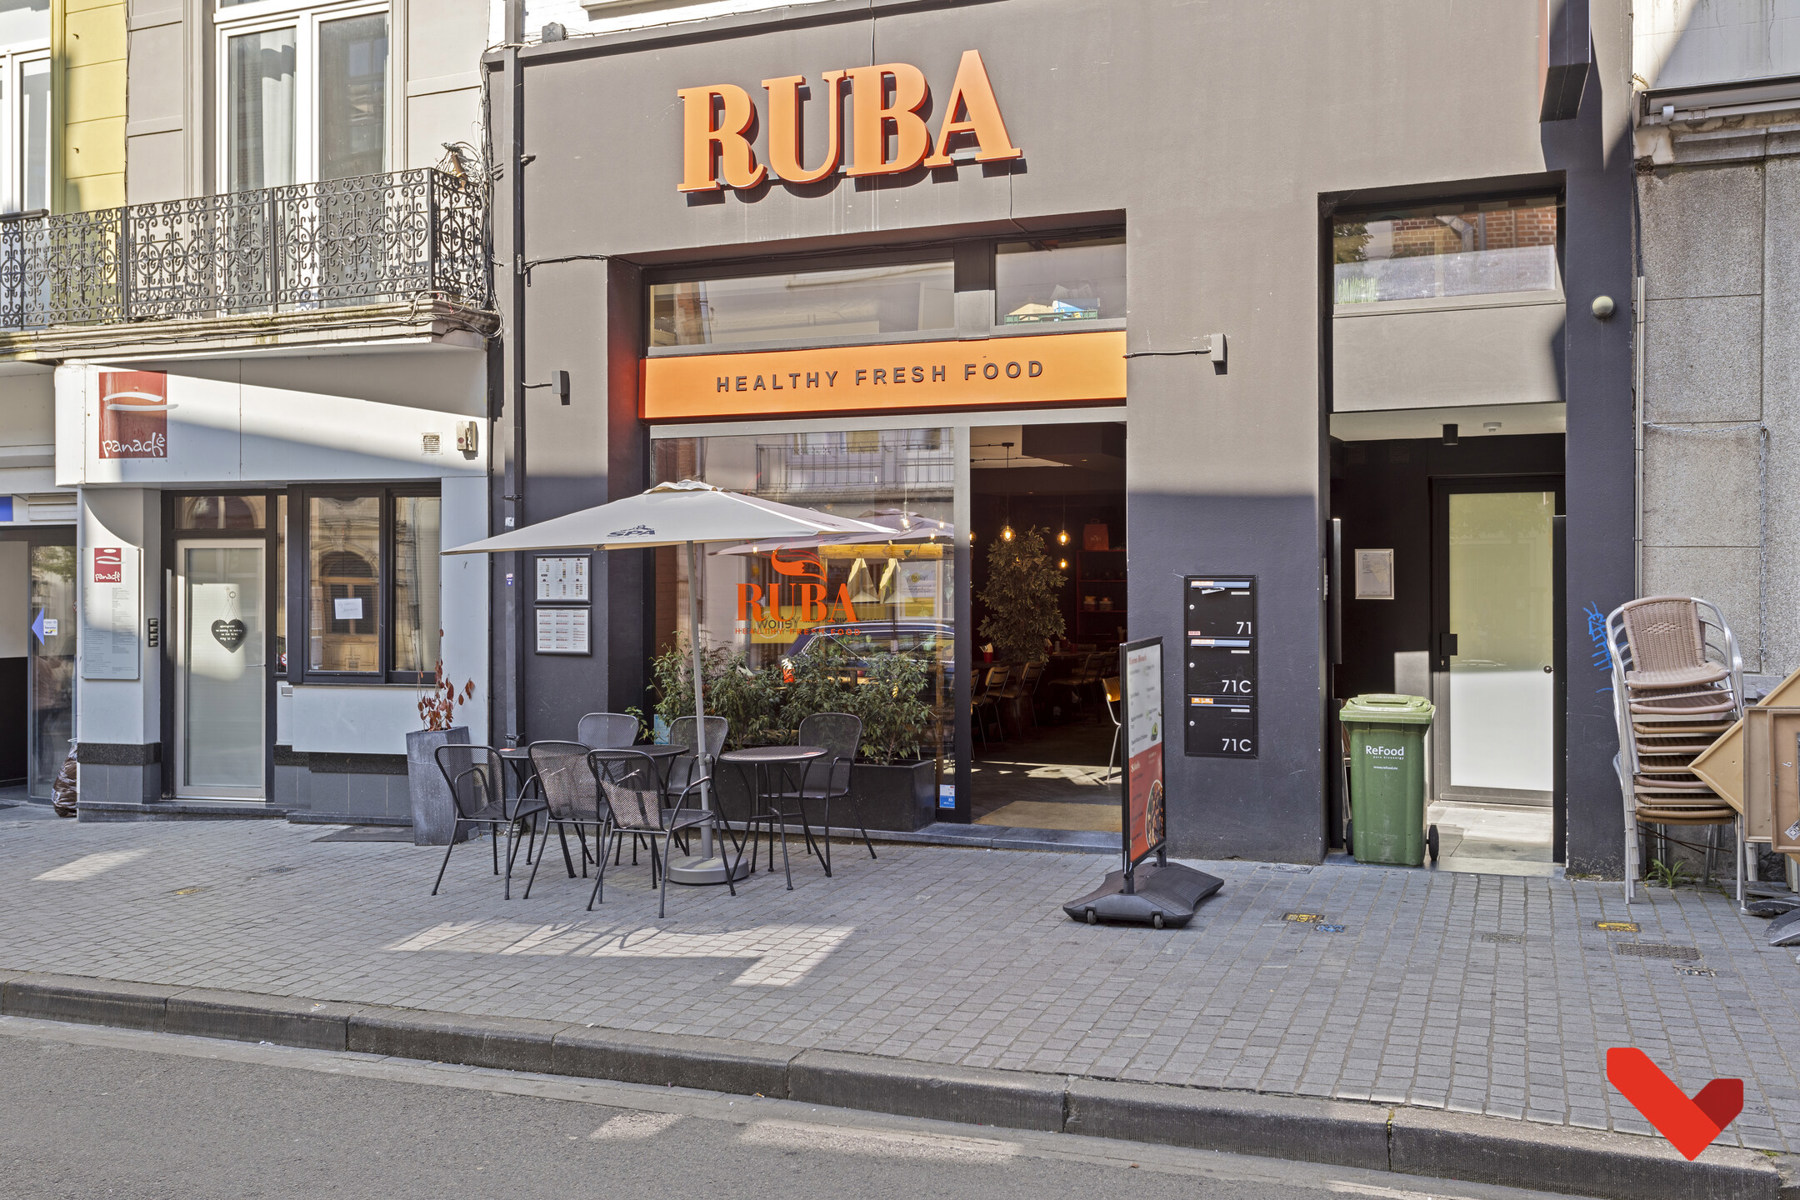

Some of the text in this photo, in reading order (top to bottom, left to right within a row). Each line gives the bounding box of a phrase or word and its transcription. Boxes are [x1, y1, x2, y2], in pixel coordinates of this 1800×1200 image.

[677, 49, 1023, 192] RUBA
[716, 360, 1043, 392] HEALTHY FRESH FOOD
[736, 583, 860, 623] RUBA
[789, 628, 822, 636] FRESH
[831, 628, 860, 636] FOOD
[1236, 621, 1252, 635] 71
[1221, 679, 1252, 693] 71C
[1221, 738, 1252, 752] 71C
[1365, 745, 1404, 756] ReFood
